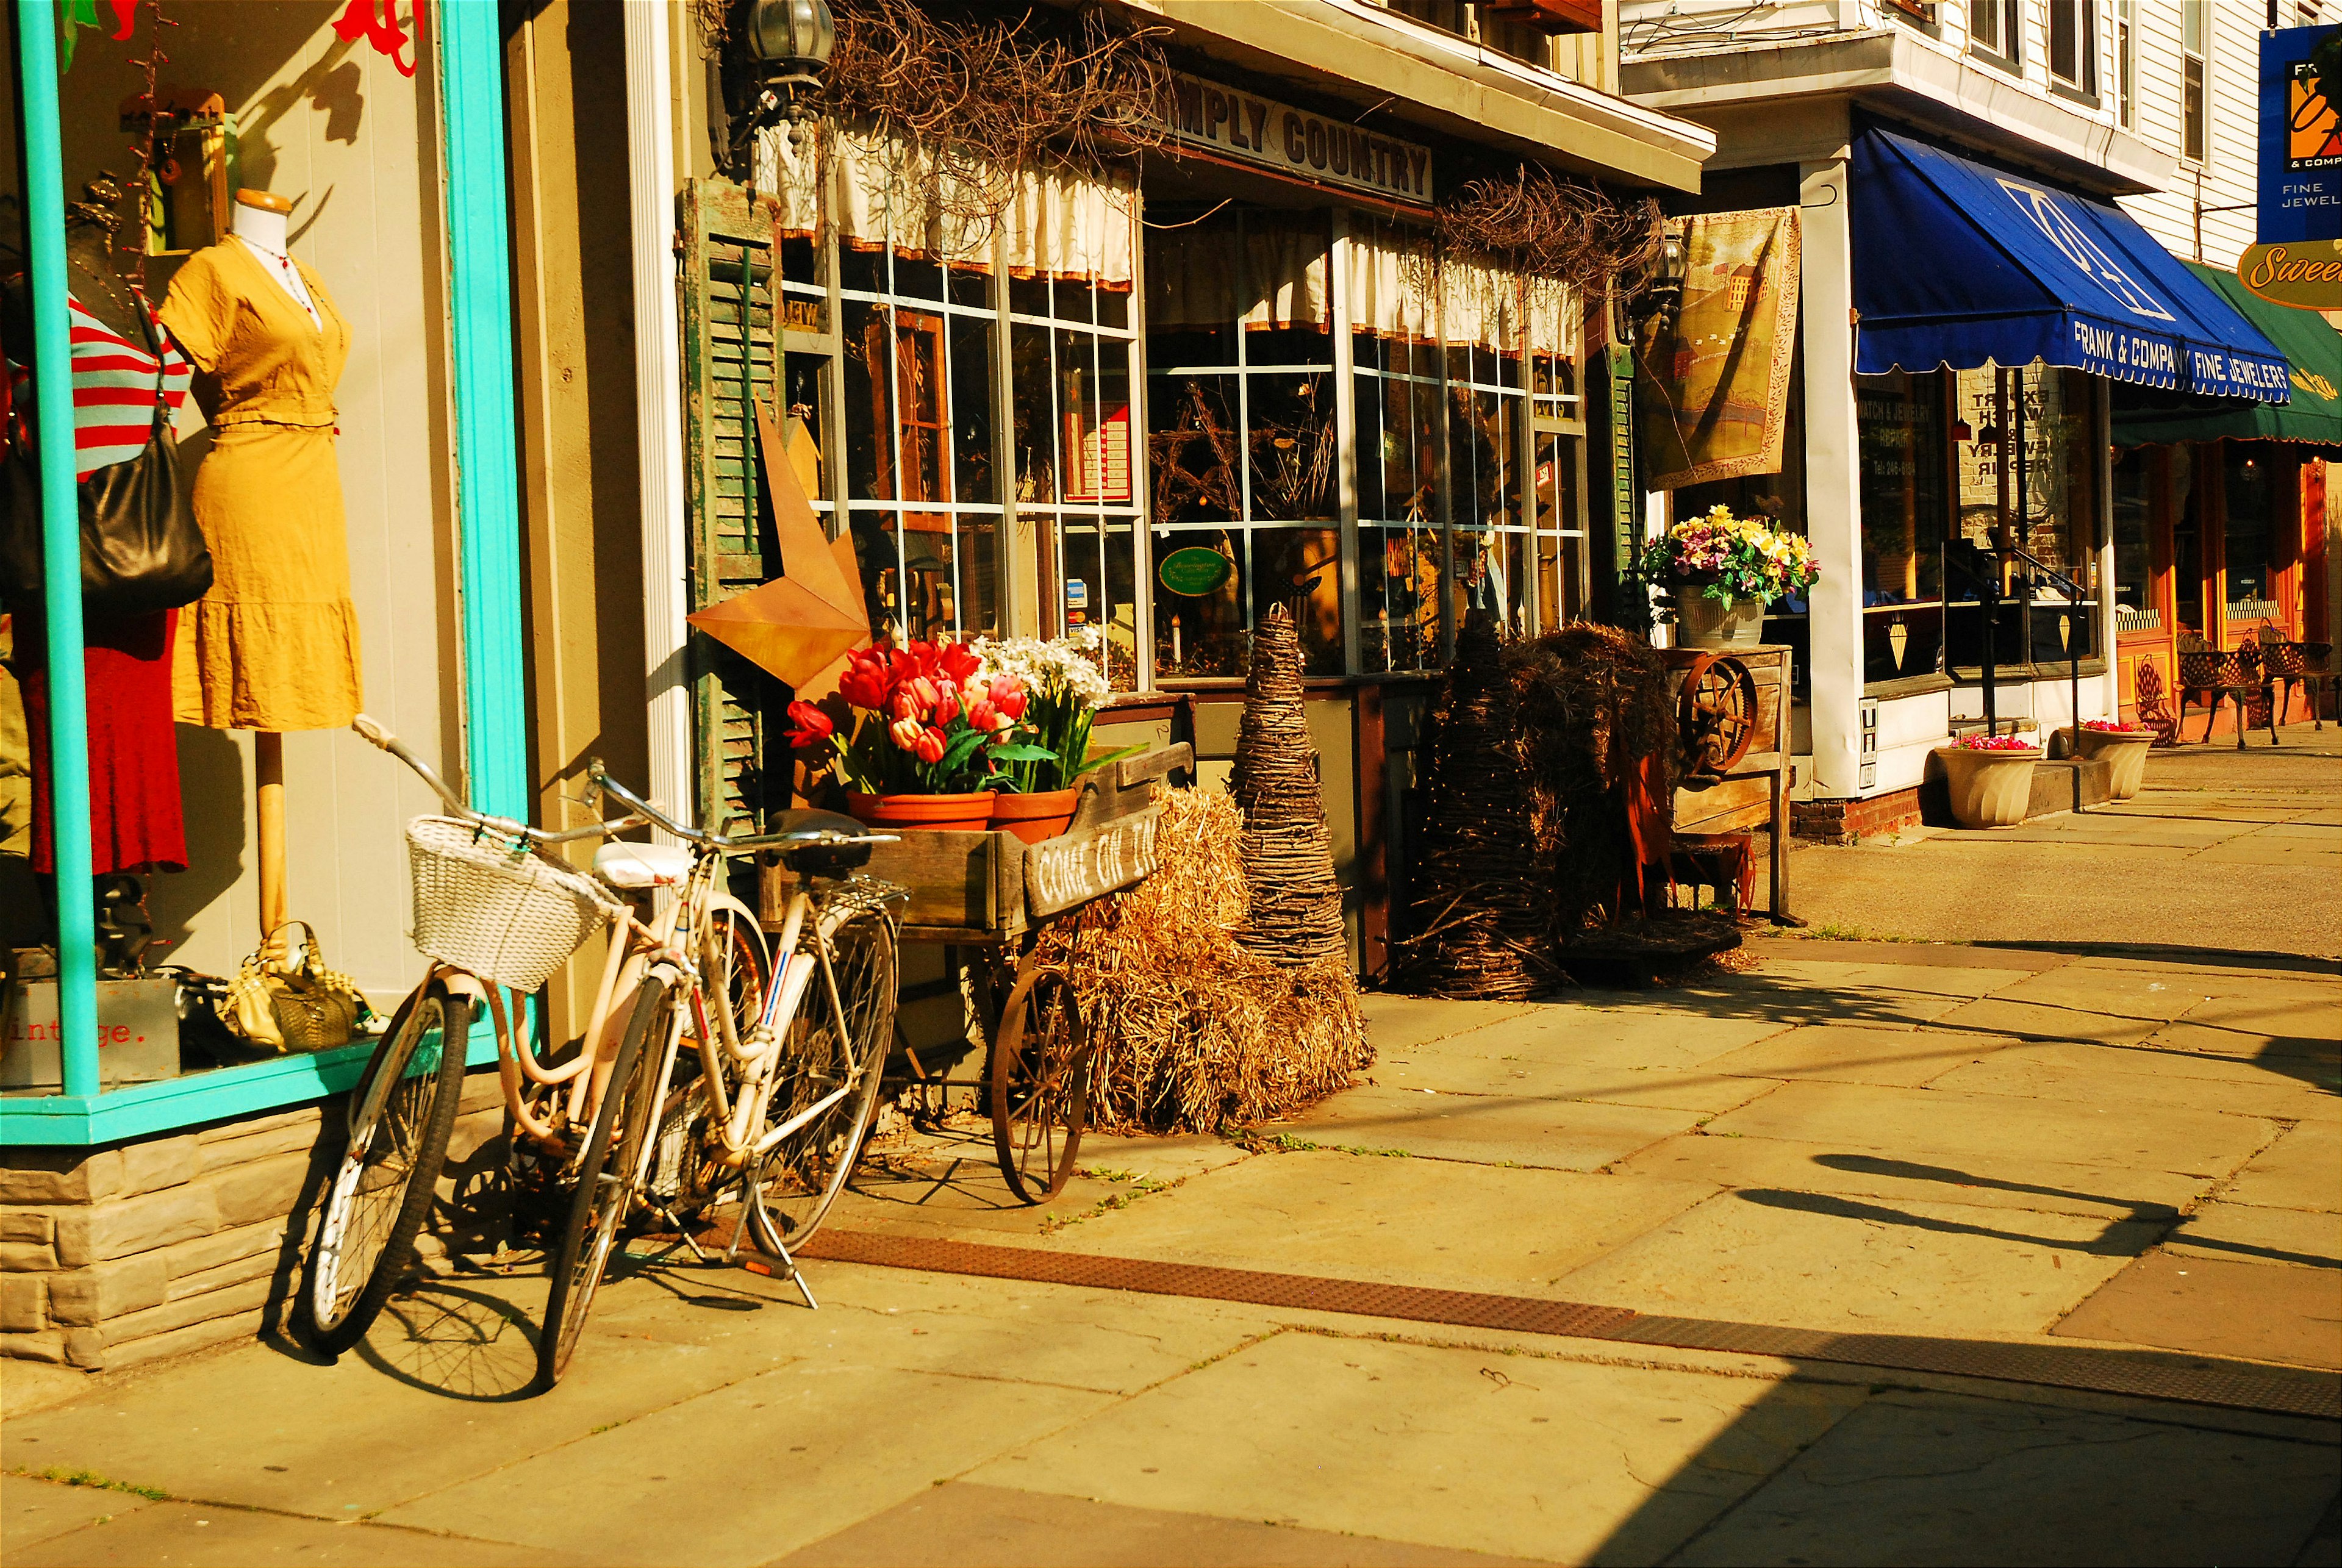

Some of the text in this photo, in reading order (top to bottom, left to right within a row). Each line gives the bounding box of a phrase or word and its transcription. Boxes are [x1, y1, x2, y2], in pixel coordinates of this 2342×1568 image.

[1283, 111, 1427, 196] COUNTRY
[2305, 157, 2342, 166] COMP
[2283, 183, 2323, 195] FINE
[2282, 195, 2341, 208] JEWEL
[2249, 246, 2342, 288] Swee
[2074, 320, 2115, 361] FRANK
[2118, 334, 2127, 364] &
[2132, 337, 2190, 376] COMPANY
[2194, 351, 2227, 381] FINE
[2228, 357, 2288, 390] JEWELERS
[1858, 399, 1884, 420] WATCH
[1893, 403, 1930, 423] JEWELRY
[1880, 428, 1911, 448] REPAIR
[1873, 460, 1885, 475] Tel:
[1038, 815, 1157, 904] COME ON IN
[10, 1017, 145, 1048] intge.
